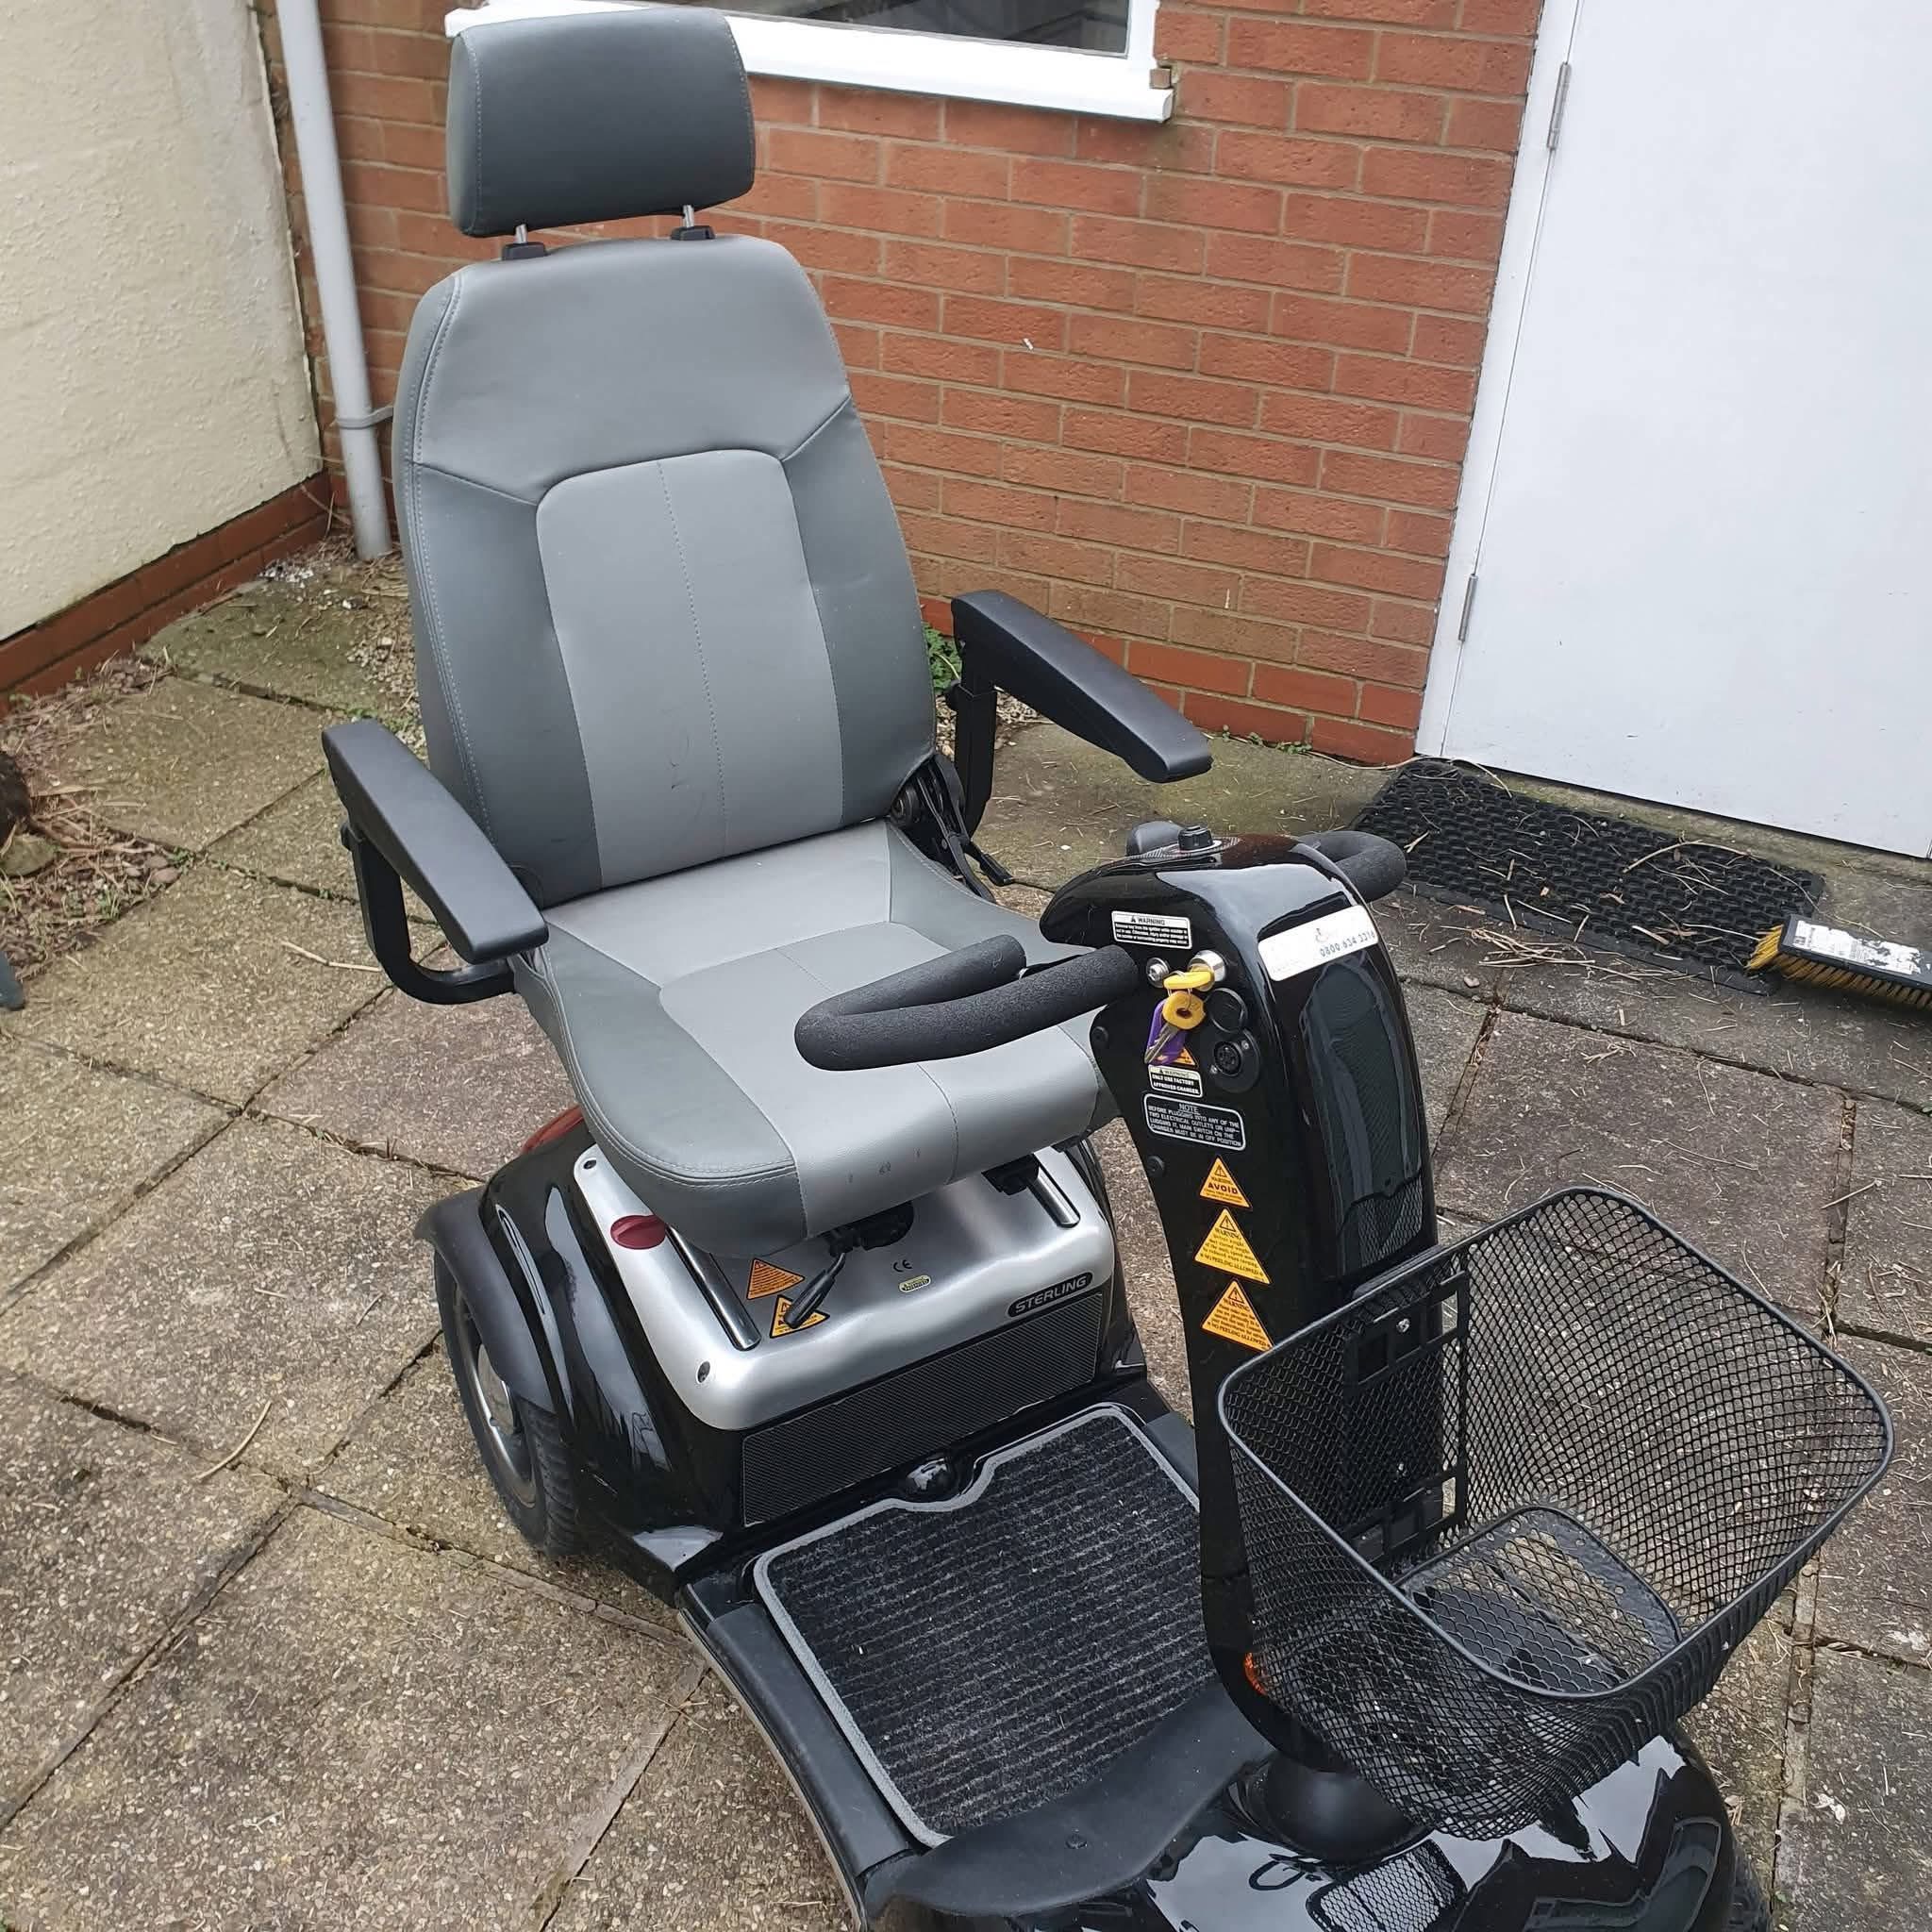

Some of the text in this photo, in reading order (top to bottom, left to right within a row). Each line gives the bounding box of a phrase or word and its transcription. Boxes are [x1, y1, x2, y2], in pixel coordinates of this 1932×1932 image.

[1138, 917, 1165, 925] WARNING
[1208, 1183, 1238, 1194] AVOID
[1015, 1275, 1087, 1313] STERLING
[1224, 1298, 1250, 1311] WARNING
